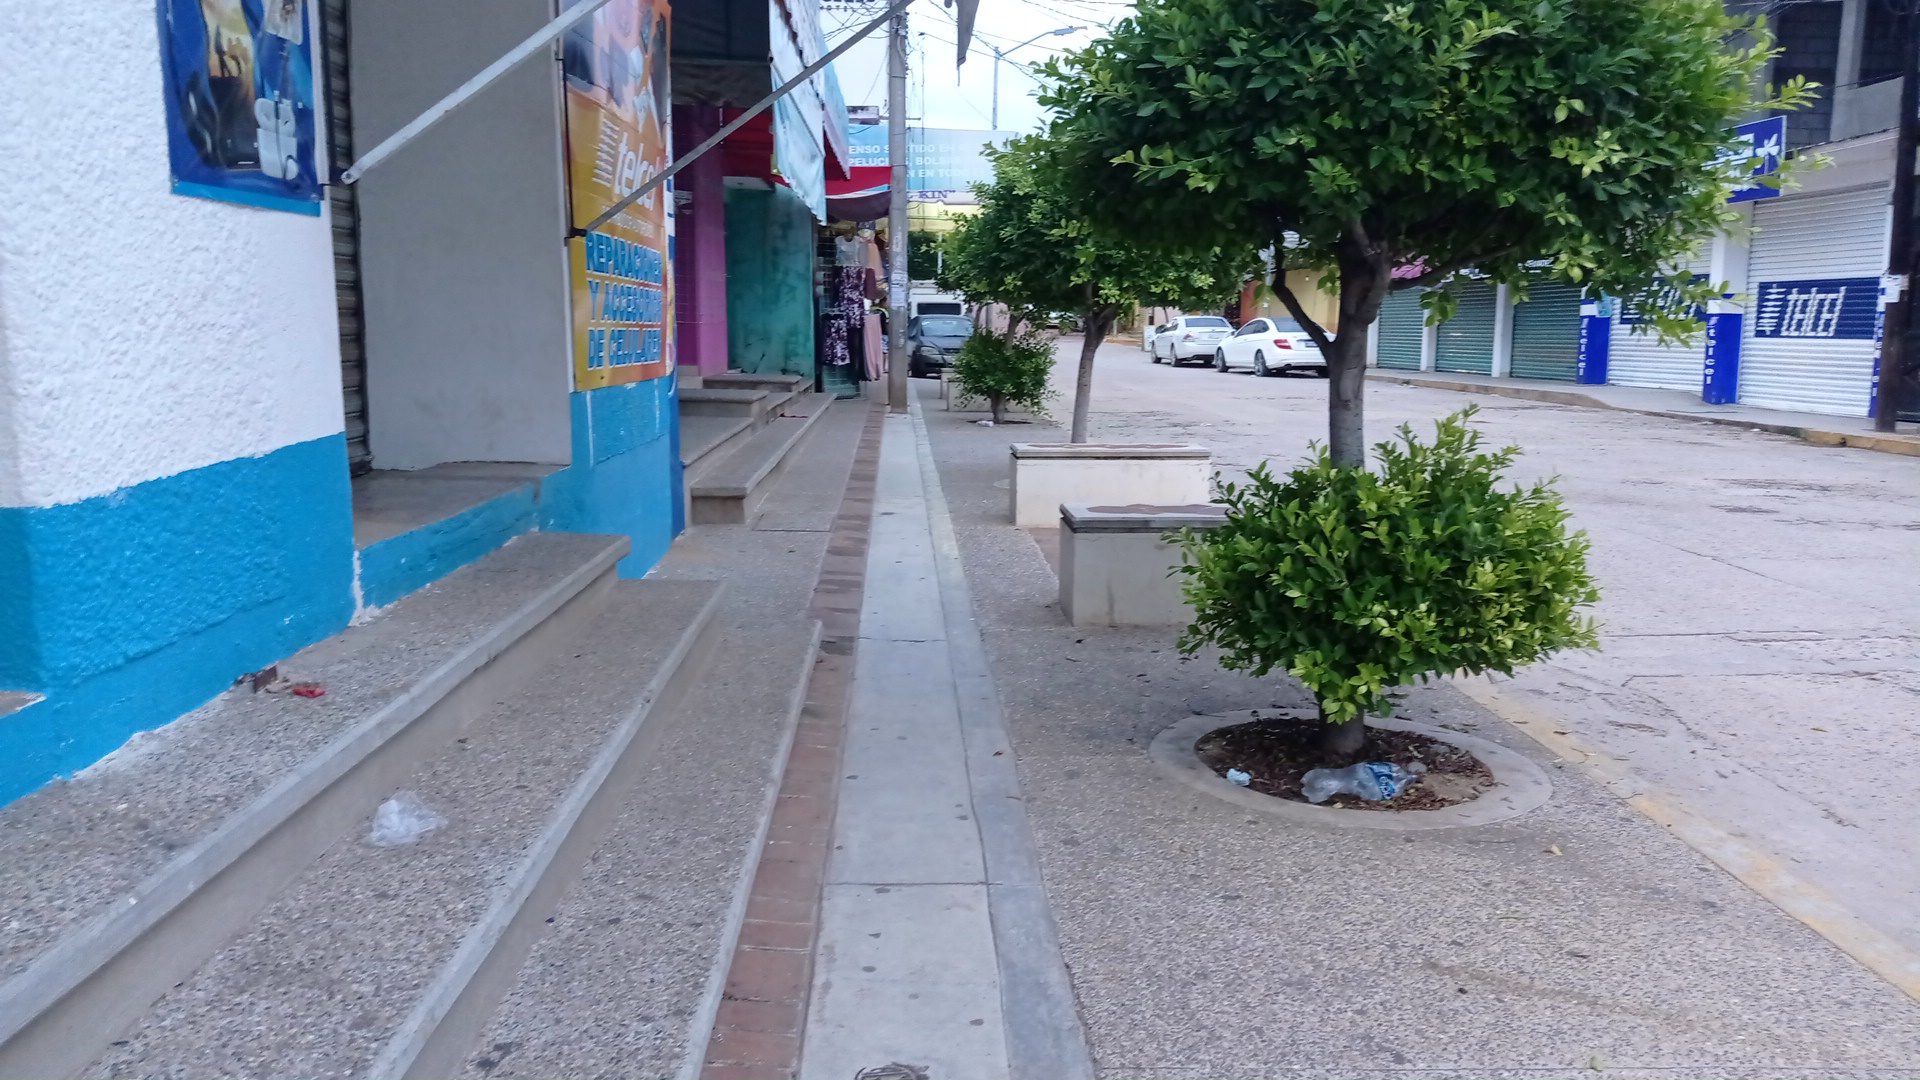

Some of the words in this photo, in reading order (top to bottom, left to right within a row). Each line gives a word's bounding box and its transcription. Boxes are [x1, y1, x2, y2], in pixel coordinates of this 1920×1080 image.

[849, 145, 880, 154] ENSO
[587, 326, 606, 371] DE
[1577, 328, 1588, 376] telcel
[1704, 328, 1717, 385] telcel
